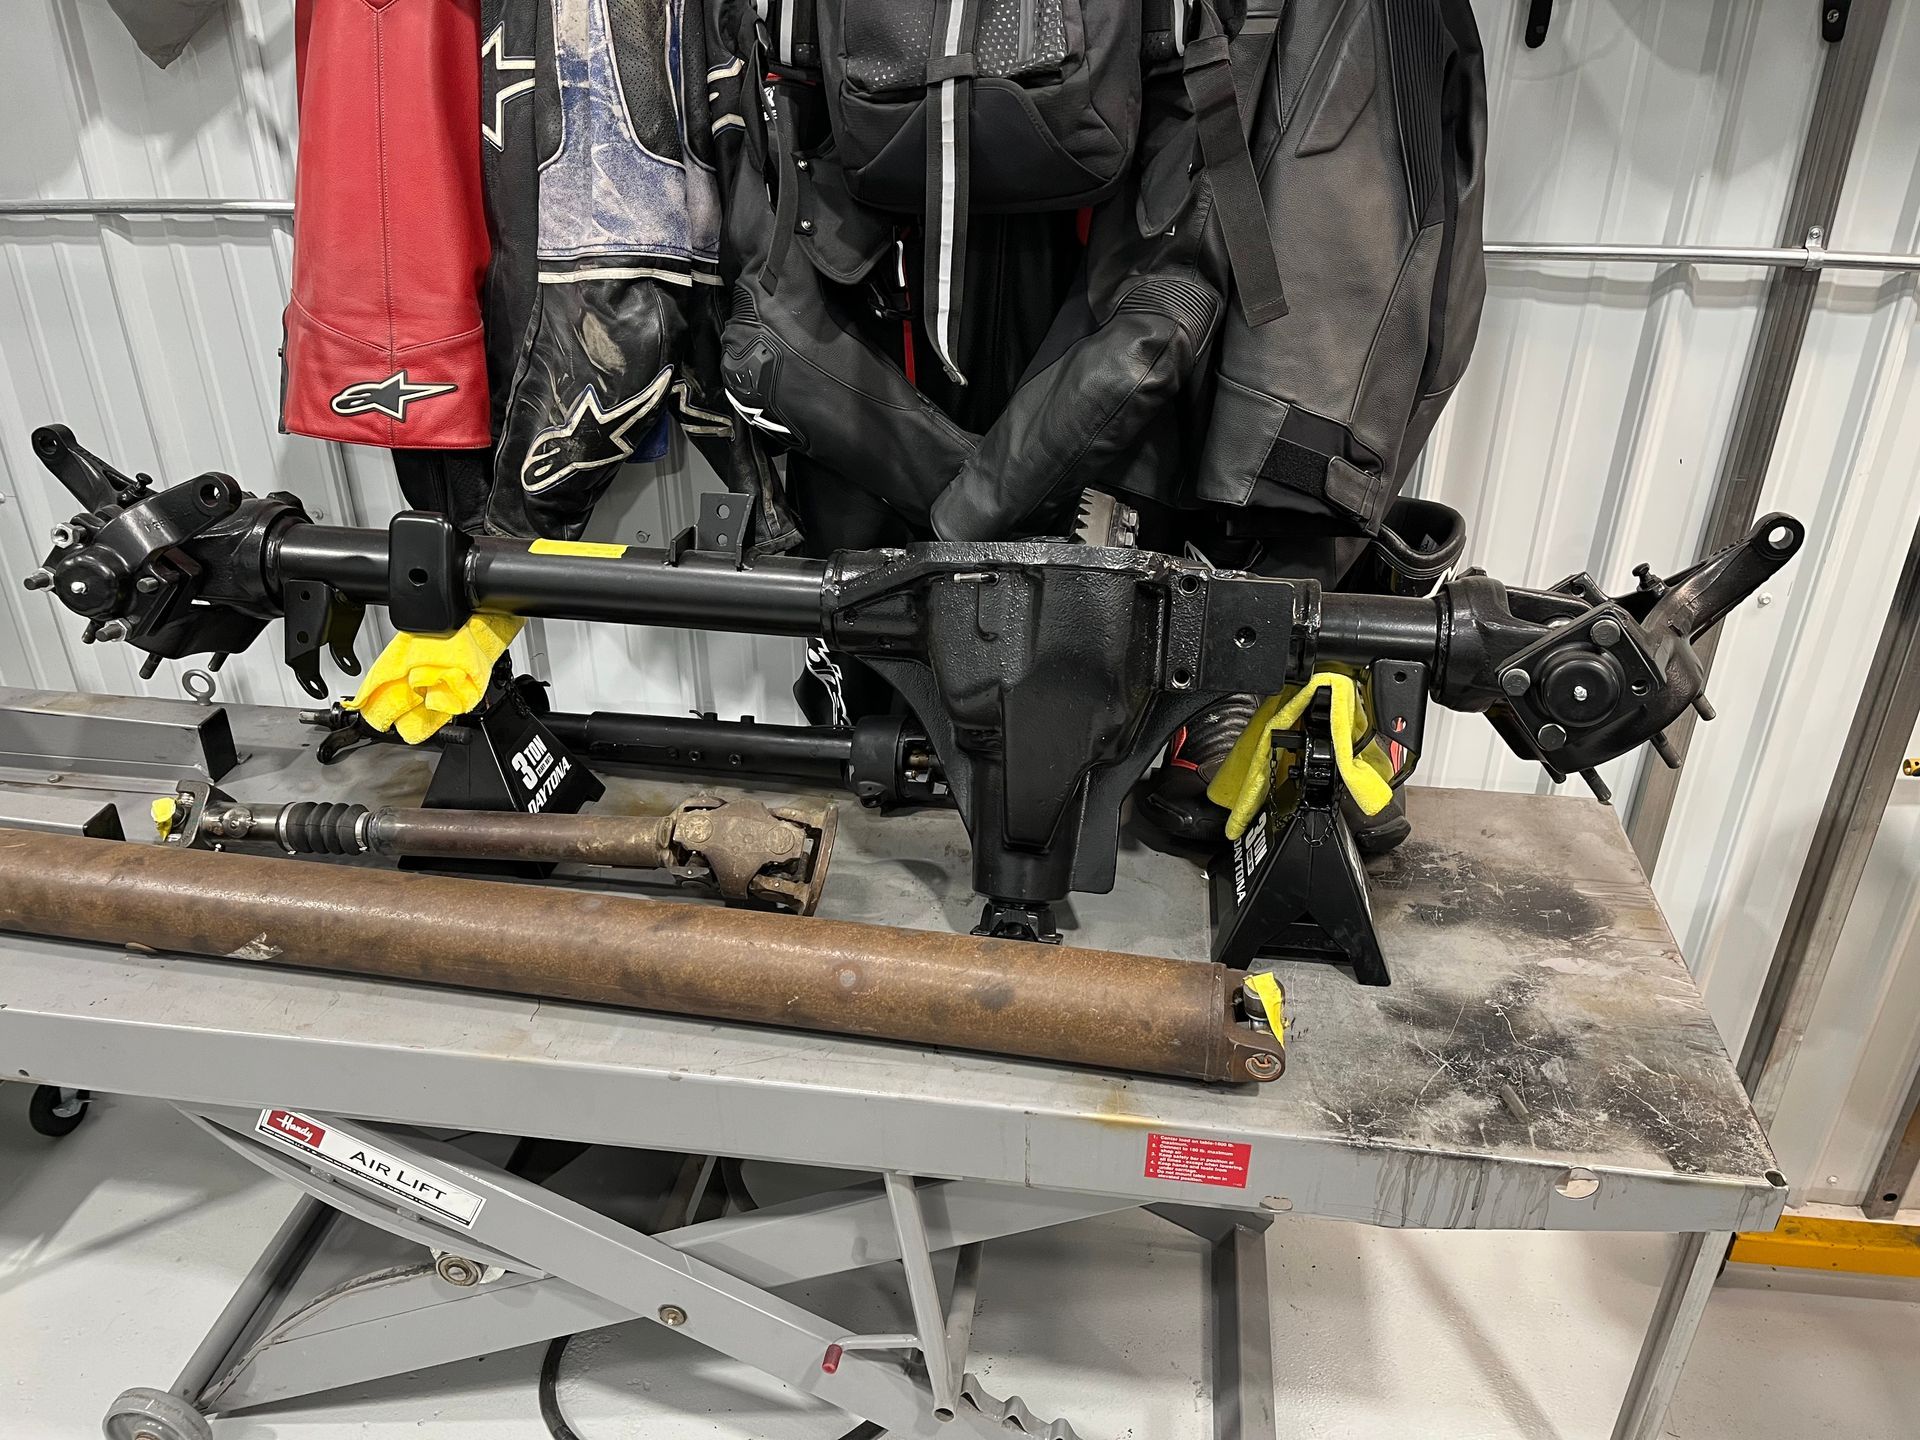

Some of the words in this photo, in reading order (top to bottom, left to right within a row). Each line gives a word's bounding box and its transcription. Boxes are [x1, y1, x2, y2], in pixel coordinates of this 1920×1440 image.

[523, 734, 548, 767] TON
[511, 752, 539, 790] 3
[1245, 811, 1267, 850] 3
[1253, 828, 1268, 867] TON
[276, 1114, 313, 1142] Handy
[349, 1150, 391, 1177] AIR
[397, 1169, 447, 1200] LIFT
